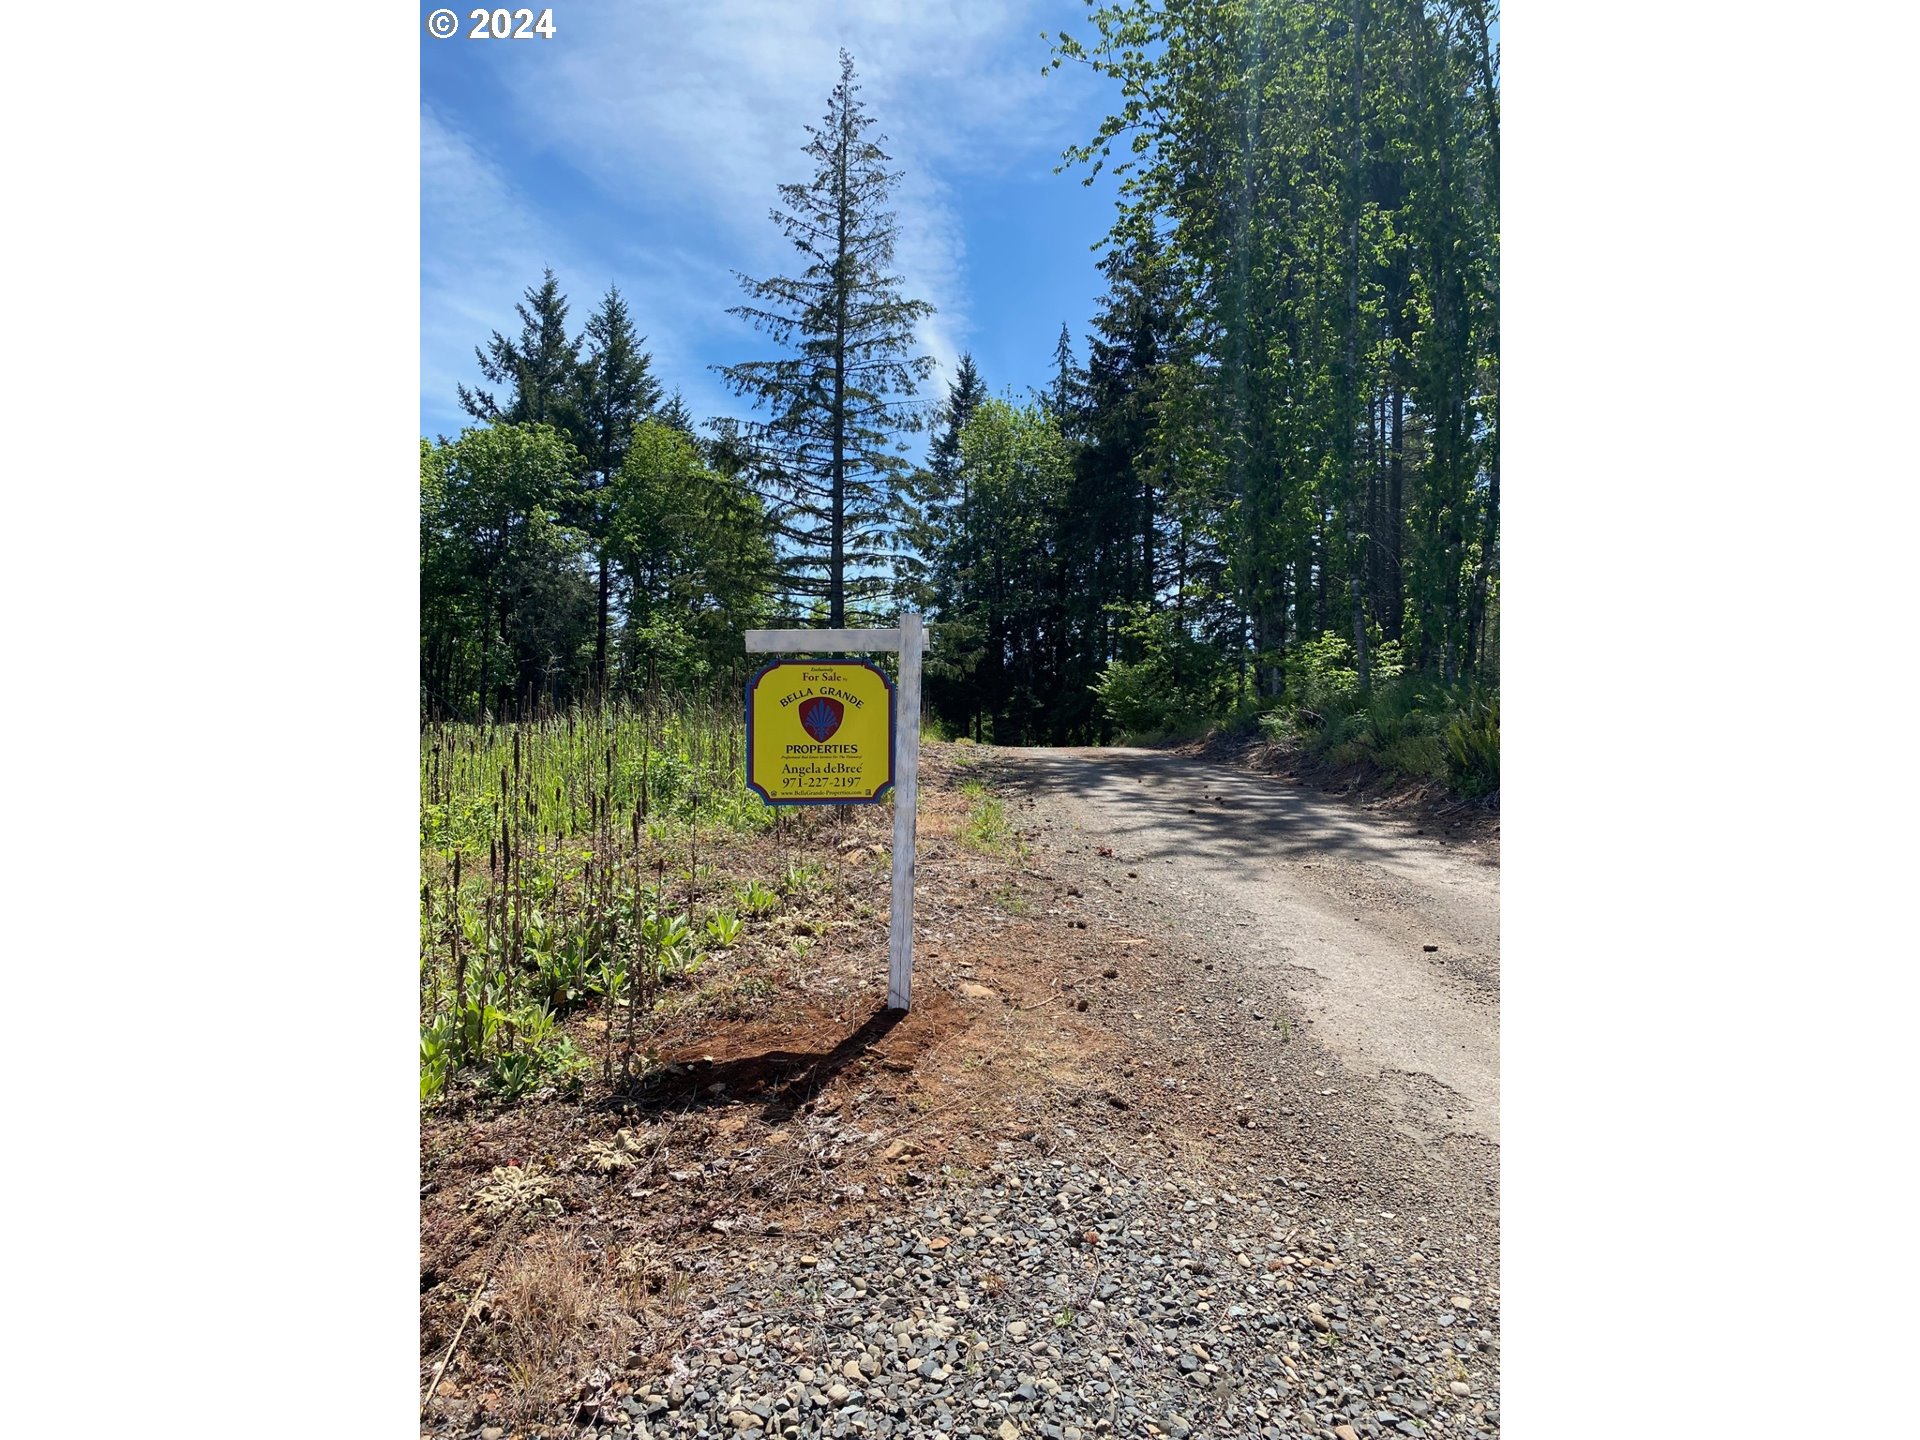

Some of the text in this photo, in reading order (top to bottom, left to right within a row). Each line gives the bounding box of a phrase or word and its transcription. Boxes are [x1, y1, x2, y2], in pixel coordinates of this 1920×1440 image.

[802, 672, 819, 682] For
[822, 672, 842, 682] Sale
[779, 686, 865, 709] BELLA GRANDE
[786, 744, 858, 754] PROPERTIES
[782, 763, 821, 777] Angela
[782, 777, 861, 788] 971-227-2197
